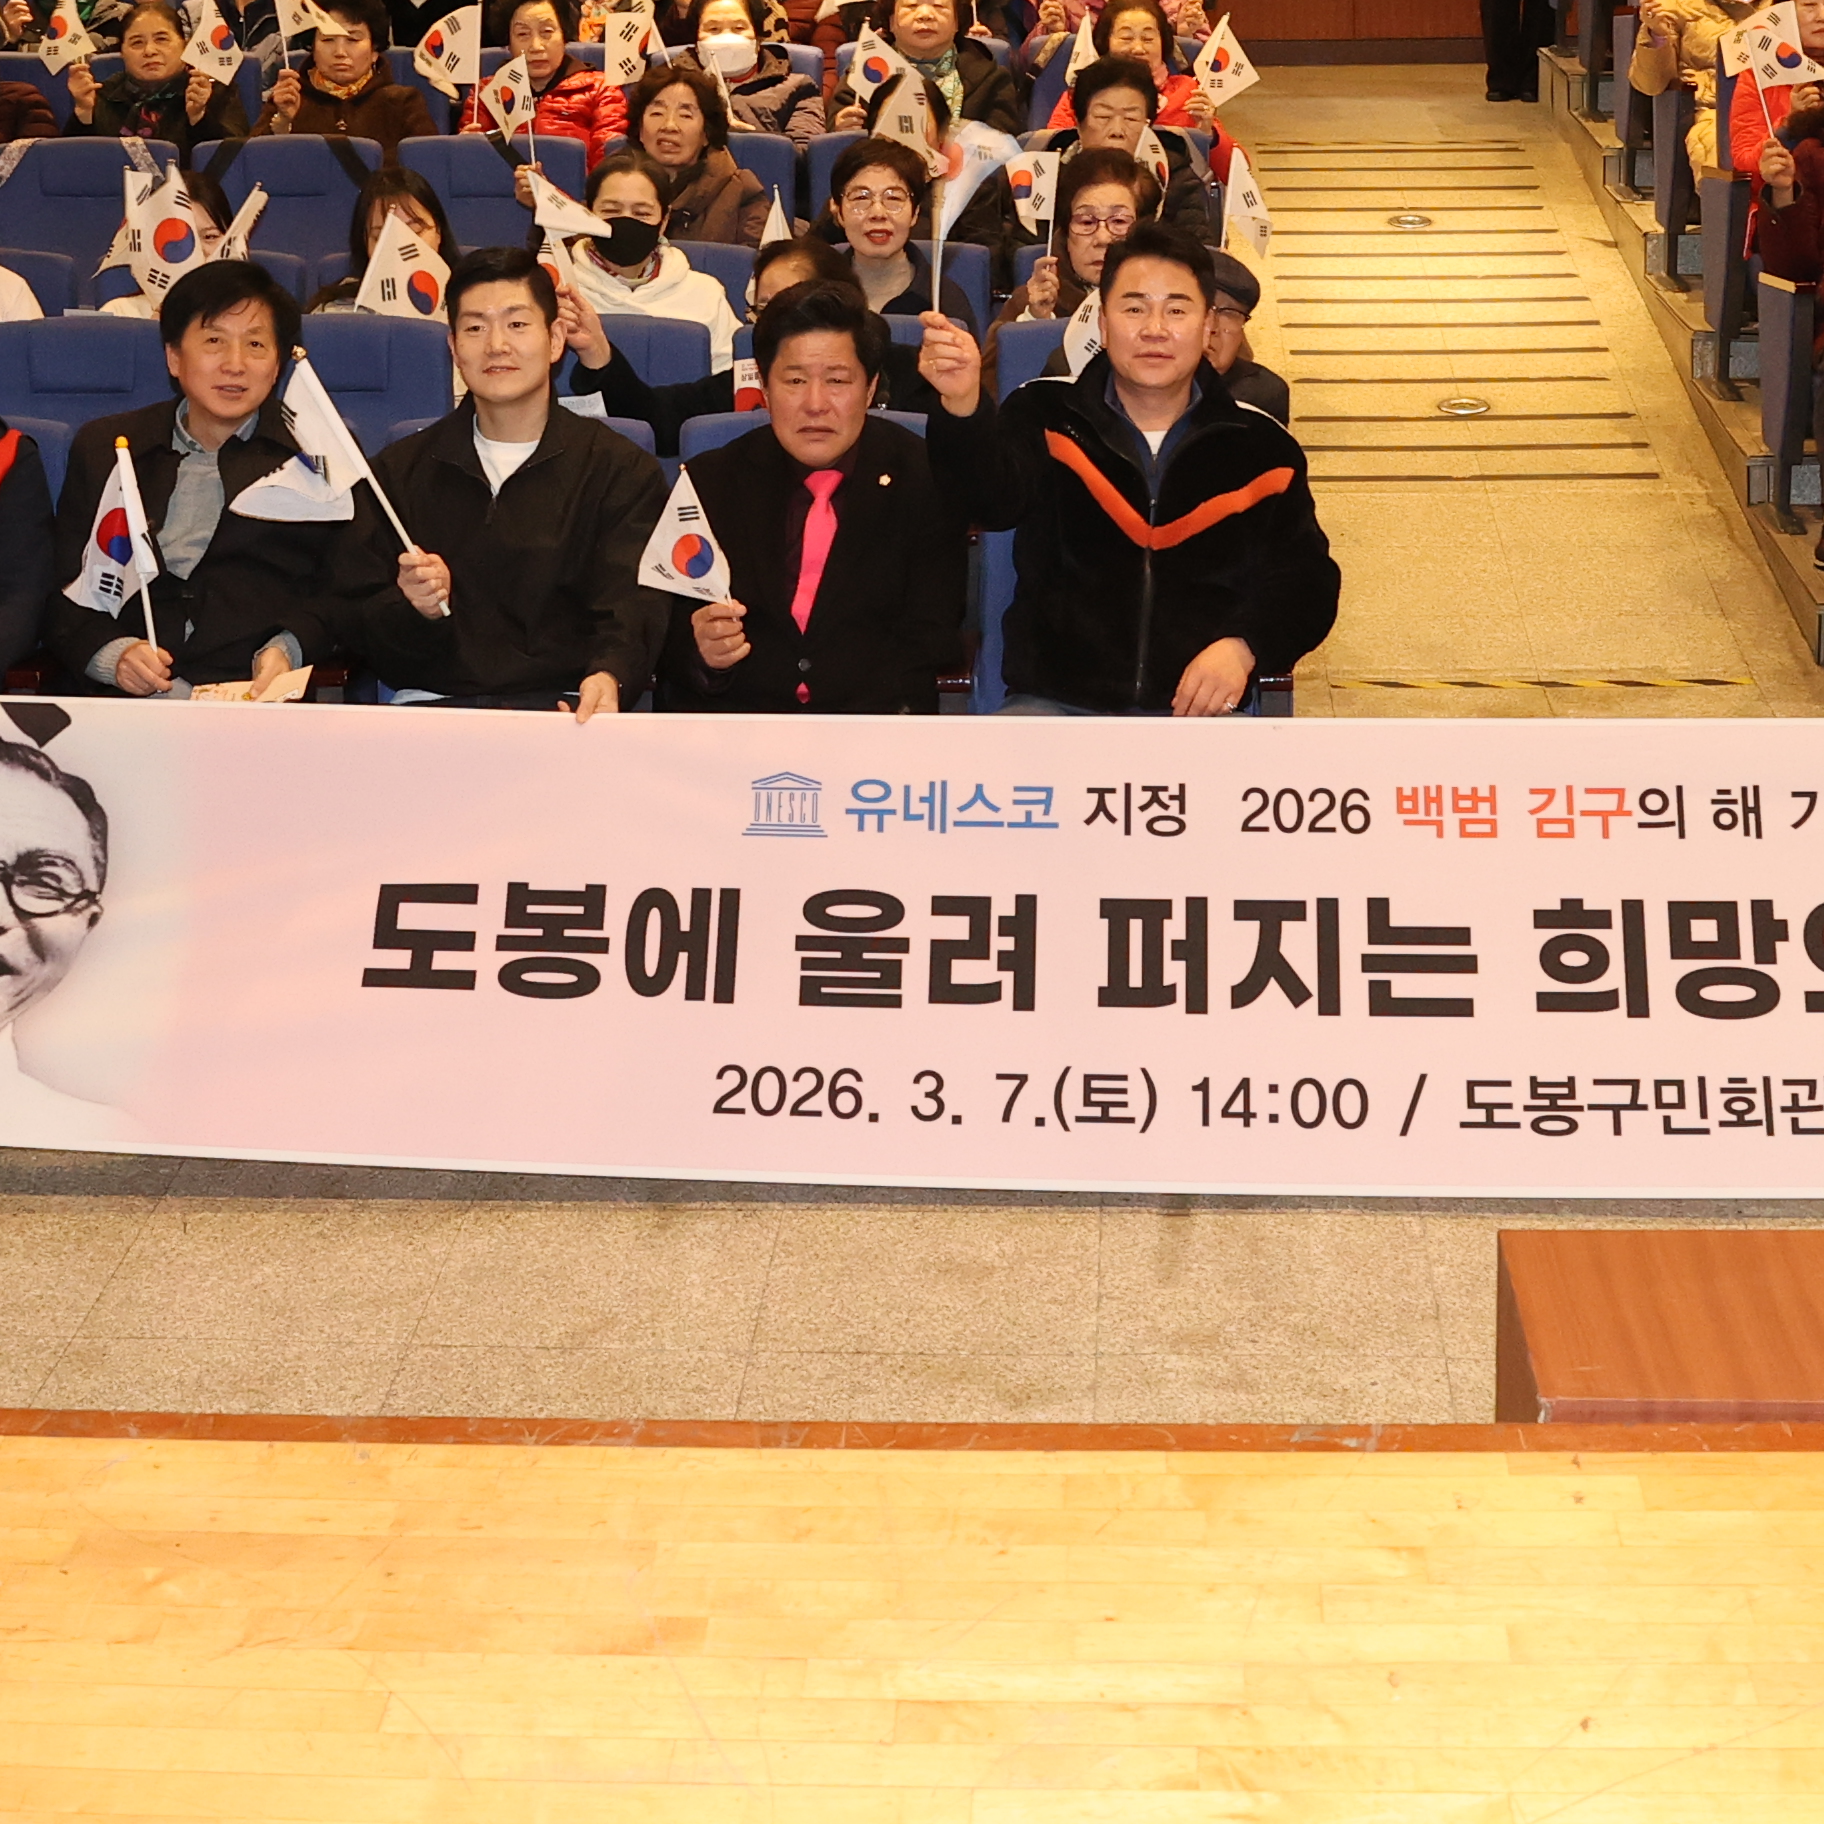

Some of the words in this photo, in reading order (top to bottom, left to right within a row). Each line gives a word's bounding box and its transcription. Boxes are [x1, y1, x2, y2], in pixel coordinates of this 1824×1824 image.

[754, 791, 819, 824] UNESCO
[845, 779, 1059, 834] 유네스코
[1084, 783, 1186, 837] 지정
[1241, 787, 1371, 834] 2026
[1396, 785, 1498, 838] 백범
[1711, 785, 1762, 839] 해
[361, 882, 741, 1004] 도봉에
[795, 889, 1037, 1011] 울려
[1098, 896, 1478, 1017] 퍼지는
[713, 1064, 879, 1123] 2026.
[911, 1070, 962, 1125] 3.
[996, 1066, 1157, 1133] 7.(토)
[1192, 1077, 1369, 1130] 14:00
